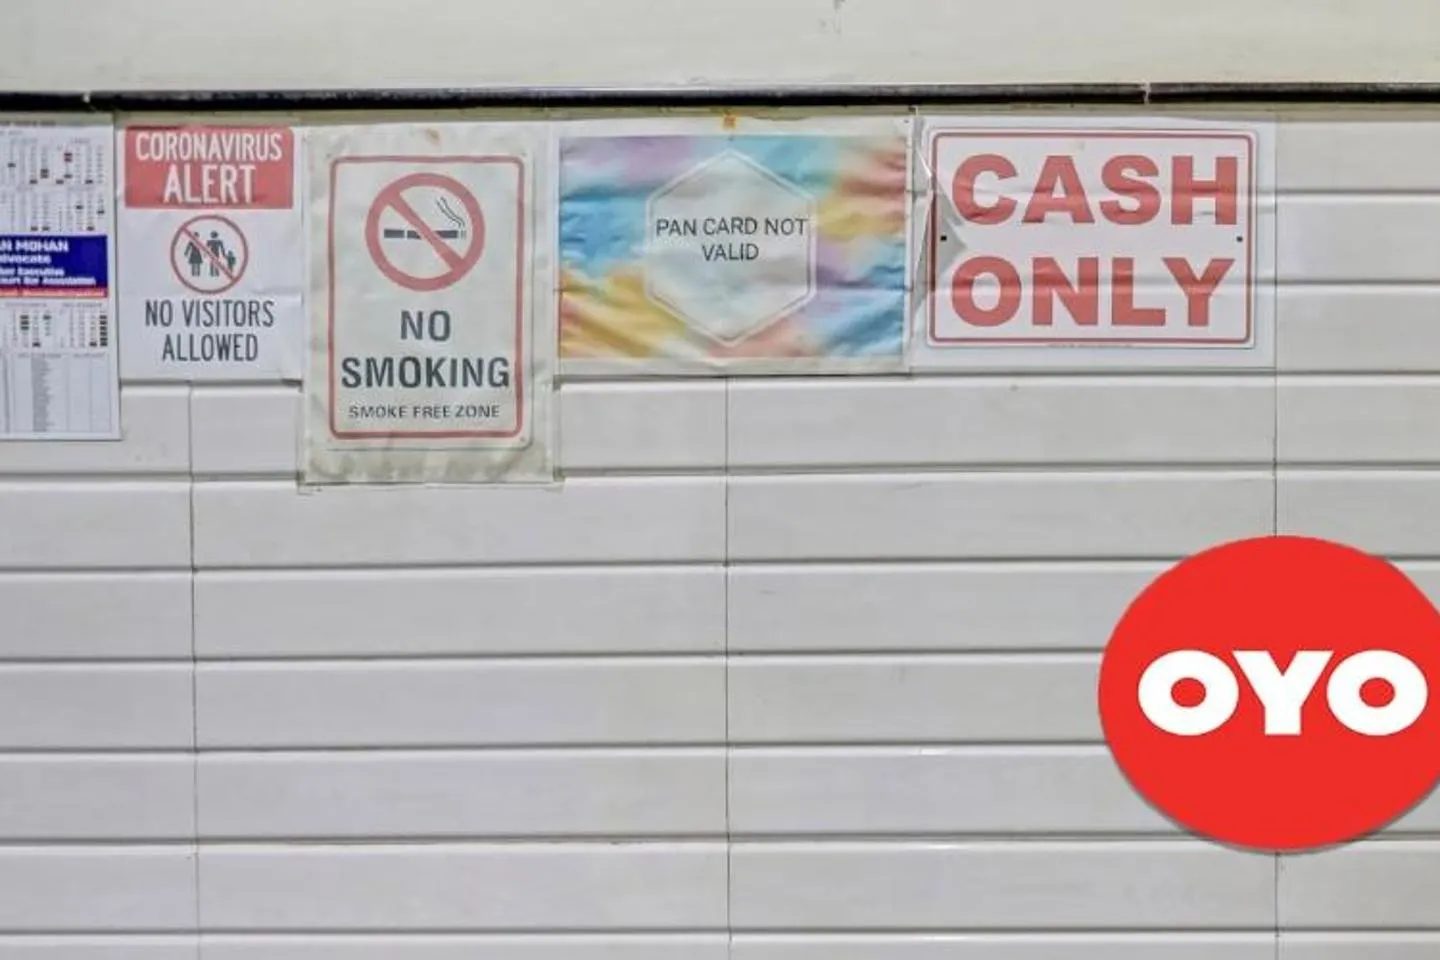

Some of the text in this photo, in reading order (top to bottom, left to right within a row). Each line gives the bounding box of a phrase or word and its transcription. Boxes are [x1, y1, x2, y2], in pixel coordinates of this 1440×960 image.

[135, 131, 282, 162] CORONAVIRUS
[163, 163, 256, 204] ALERT
[952, 153, 1238, 226] CASH
[656, 216, 808, 236] PAN CARD NOT
[702, 243, 760, 261] VALID
[951, 256, 1236, 327] ONLY
[145, 299, 275, 328] NO VISITORS
[400, 310, 451, 341] NO
[162, 333, 258, 362] ALLOWED
[341, 355, 510, 389] SMOKING
[349, 404, 501, 419] SMOKE FREE ZONE
[1137, 649, 1429, 737] OYO
